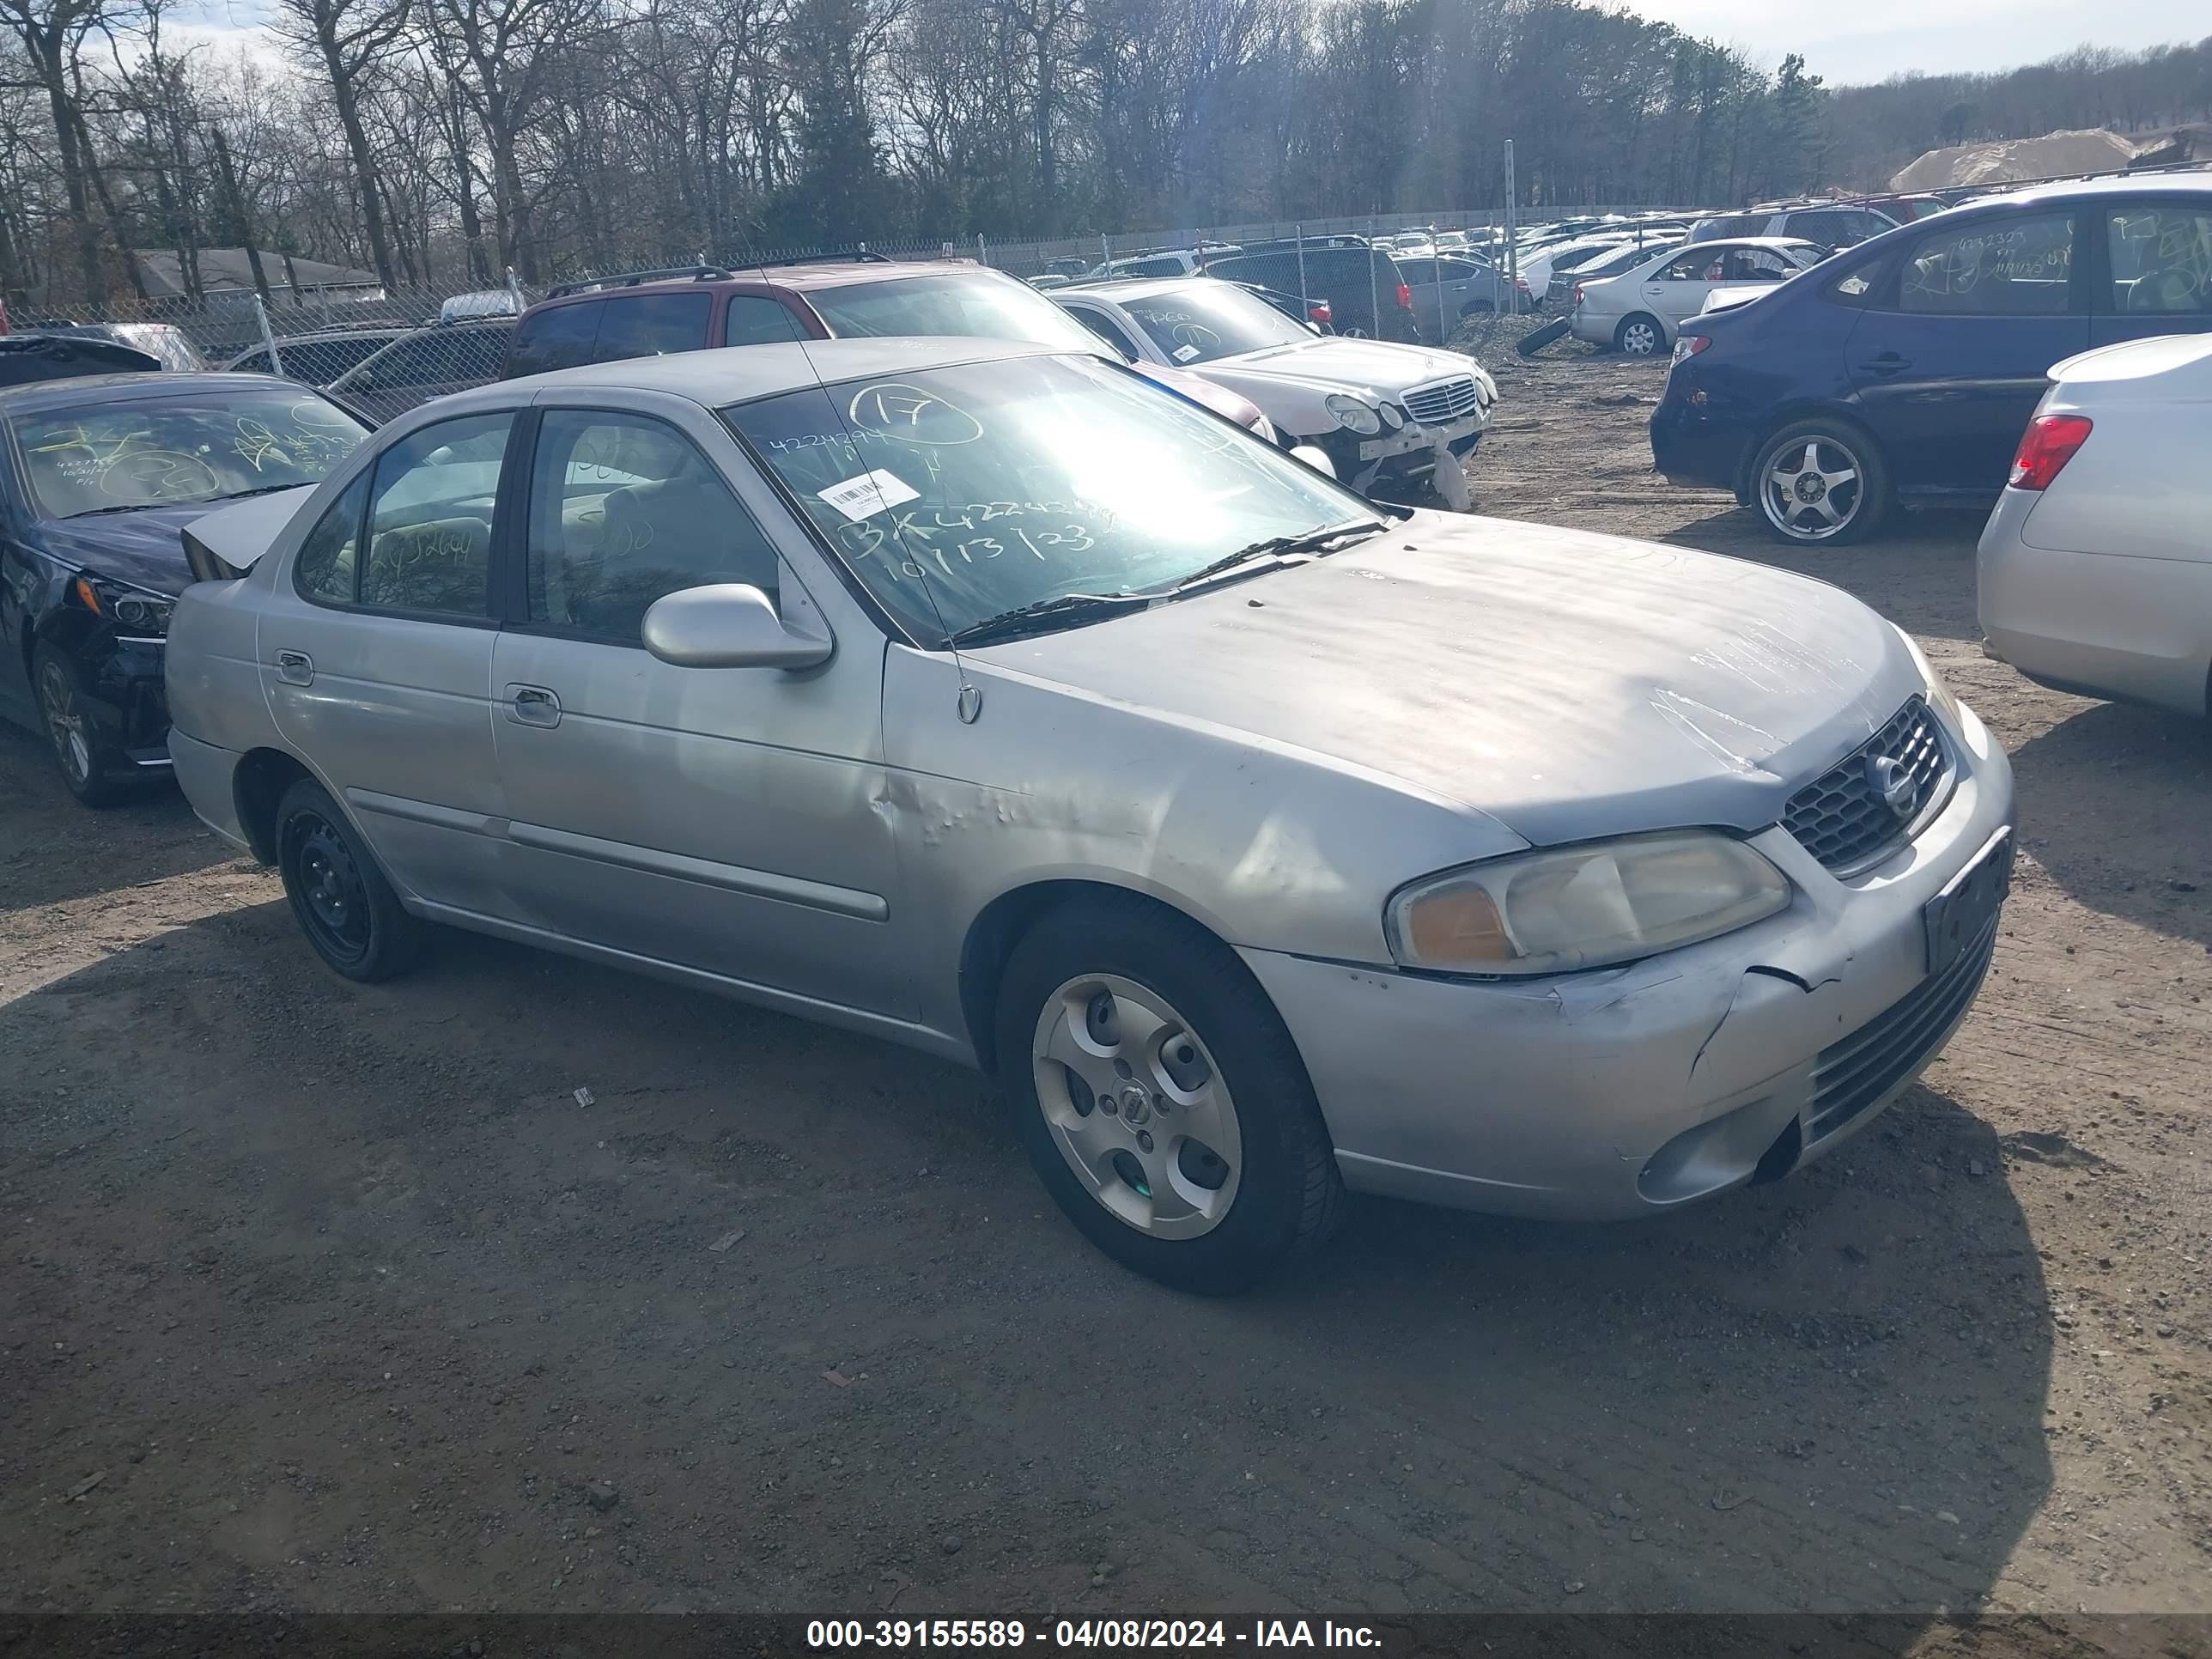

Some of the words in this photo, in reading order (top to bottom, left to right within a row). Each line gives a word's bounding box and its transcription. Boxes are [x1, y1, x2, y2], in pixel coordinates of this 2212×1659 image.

[875, 392, 933, 426] 17
[769, 428, 890, 455] 4224294
[883, 524, 1096, 582] 10/13/23
